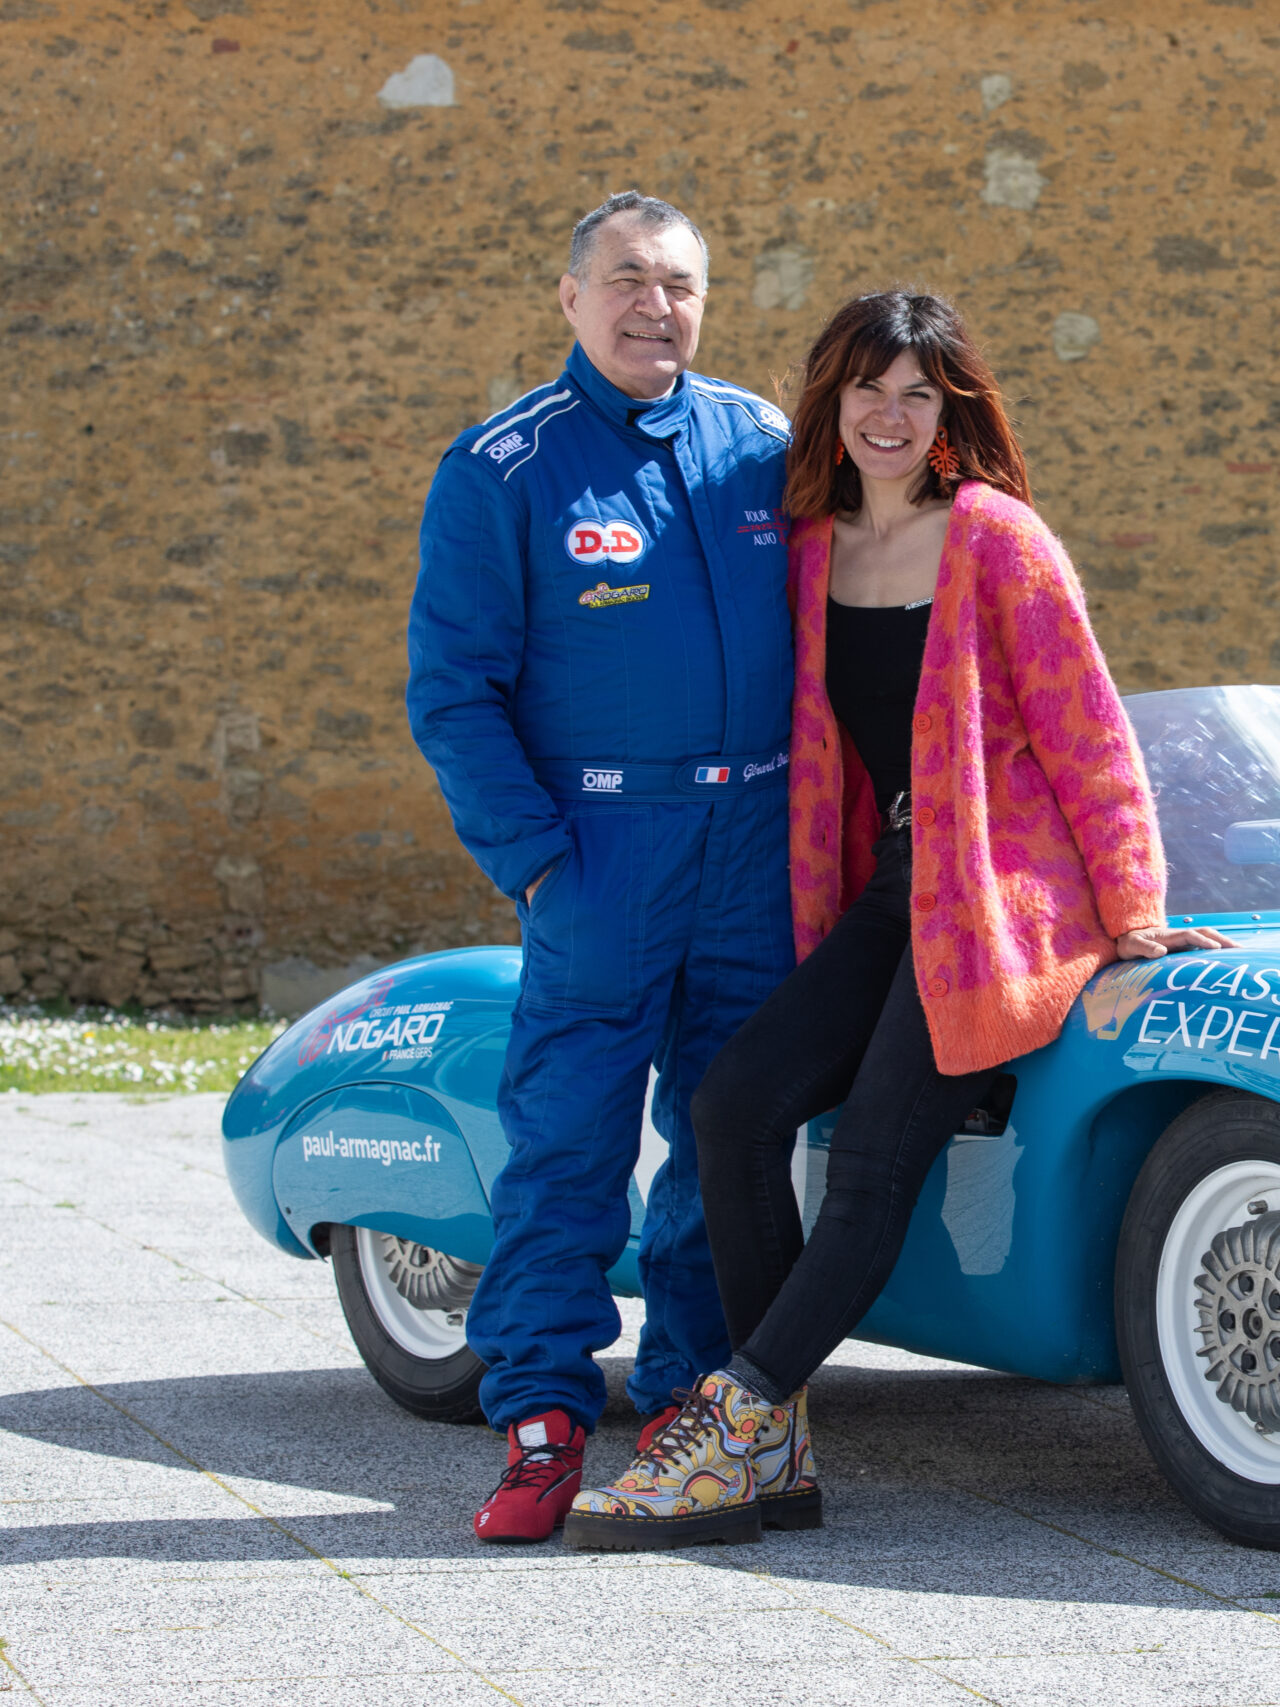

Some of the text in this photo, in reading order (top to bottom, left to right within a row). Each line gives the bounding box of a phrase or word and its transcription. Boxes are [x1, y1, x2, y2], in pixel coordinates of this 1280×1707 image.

[490, 434, 523, 460] OMP
[743, 509, 770, 522] TOUR
[753, 531, 777, 546] AUTO
[592, 586, 648, 602] NOGARO
[582, 772, 623, 789] OMP
[369, 1001, 454, 1019] CIRCUIT PAUL ARMAGNAC
[327, 1013, 446, 1055] NOGARO
[388, 1046, 432, 1060] FRANCE GERS
[303, 1130, 441, 1166] paul-armagnac.fr
